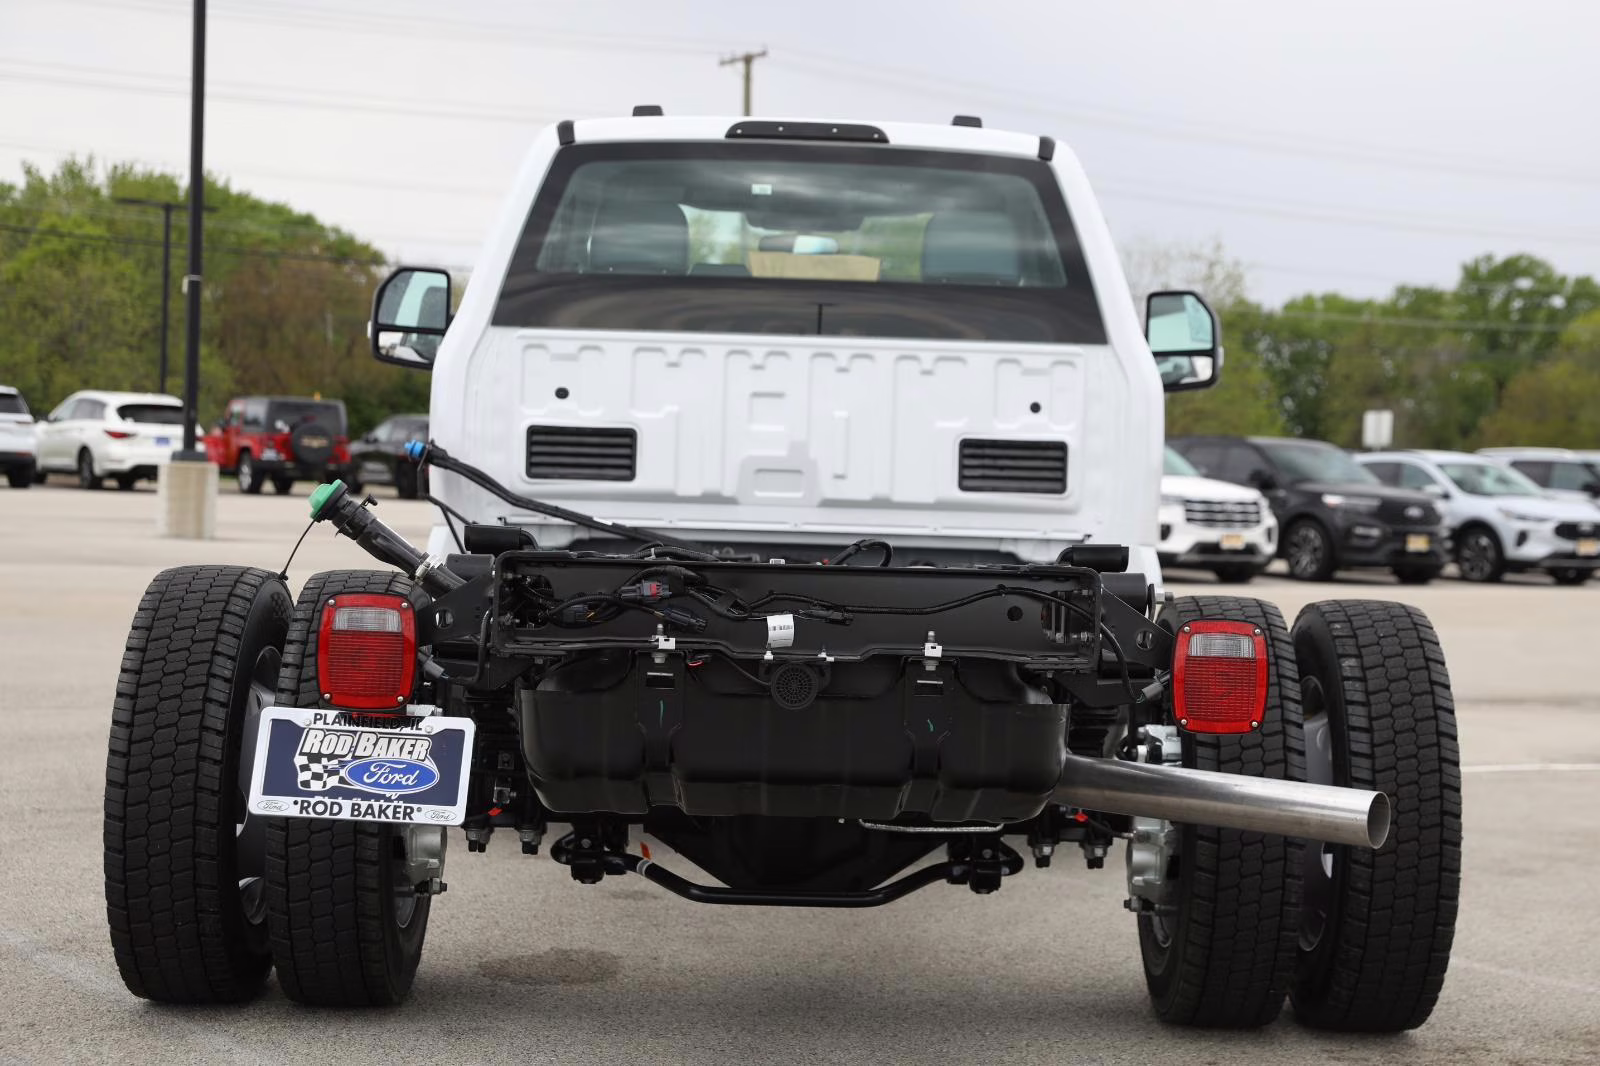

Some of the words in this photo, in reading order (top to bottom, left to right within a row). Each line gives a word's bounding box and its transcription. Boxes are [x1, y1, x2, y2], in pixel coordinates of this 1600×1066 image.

[302, 729, 355, 755] ROD
[354, 731, 430, 760] BAKER
[363, 761, 420, 785] Ford
[299, 800, 343, 816] ROD
[350, 802, 415, 821] BAKER
